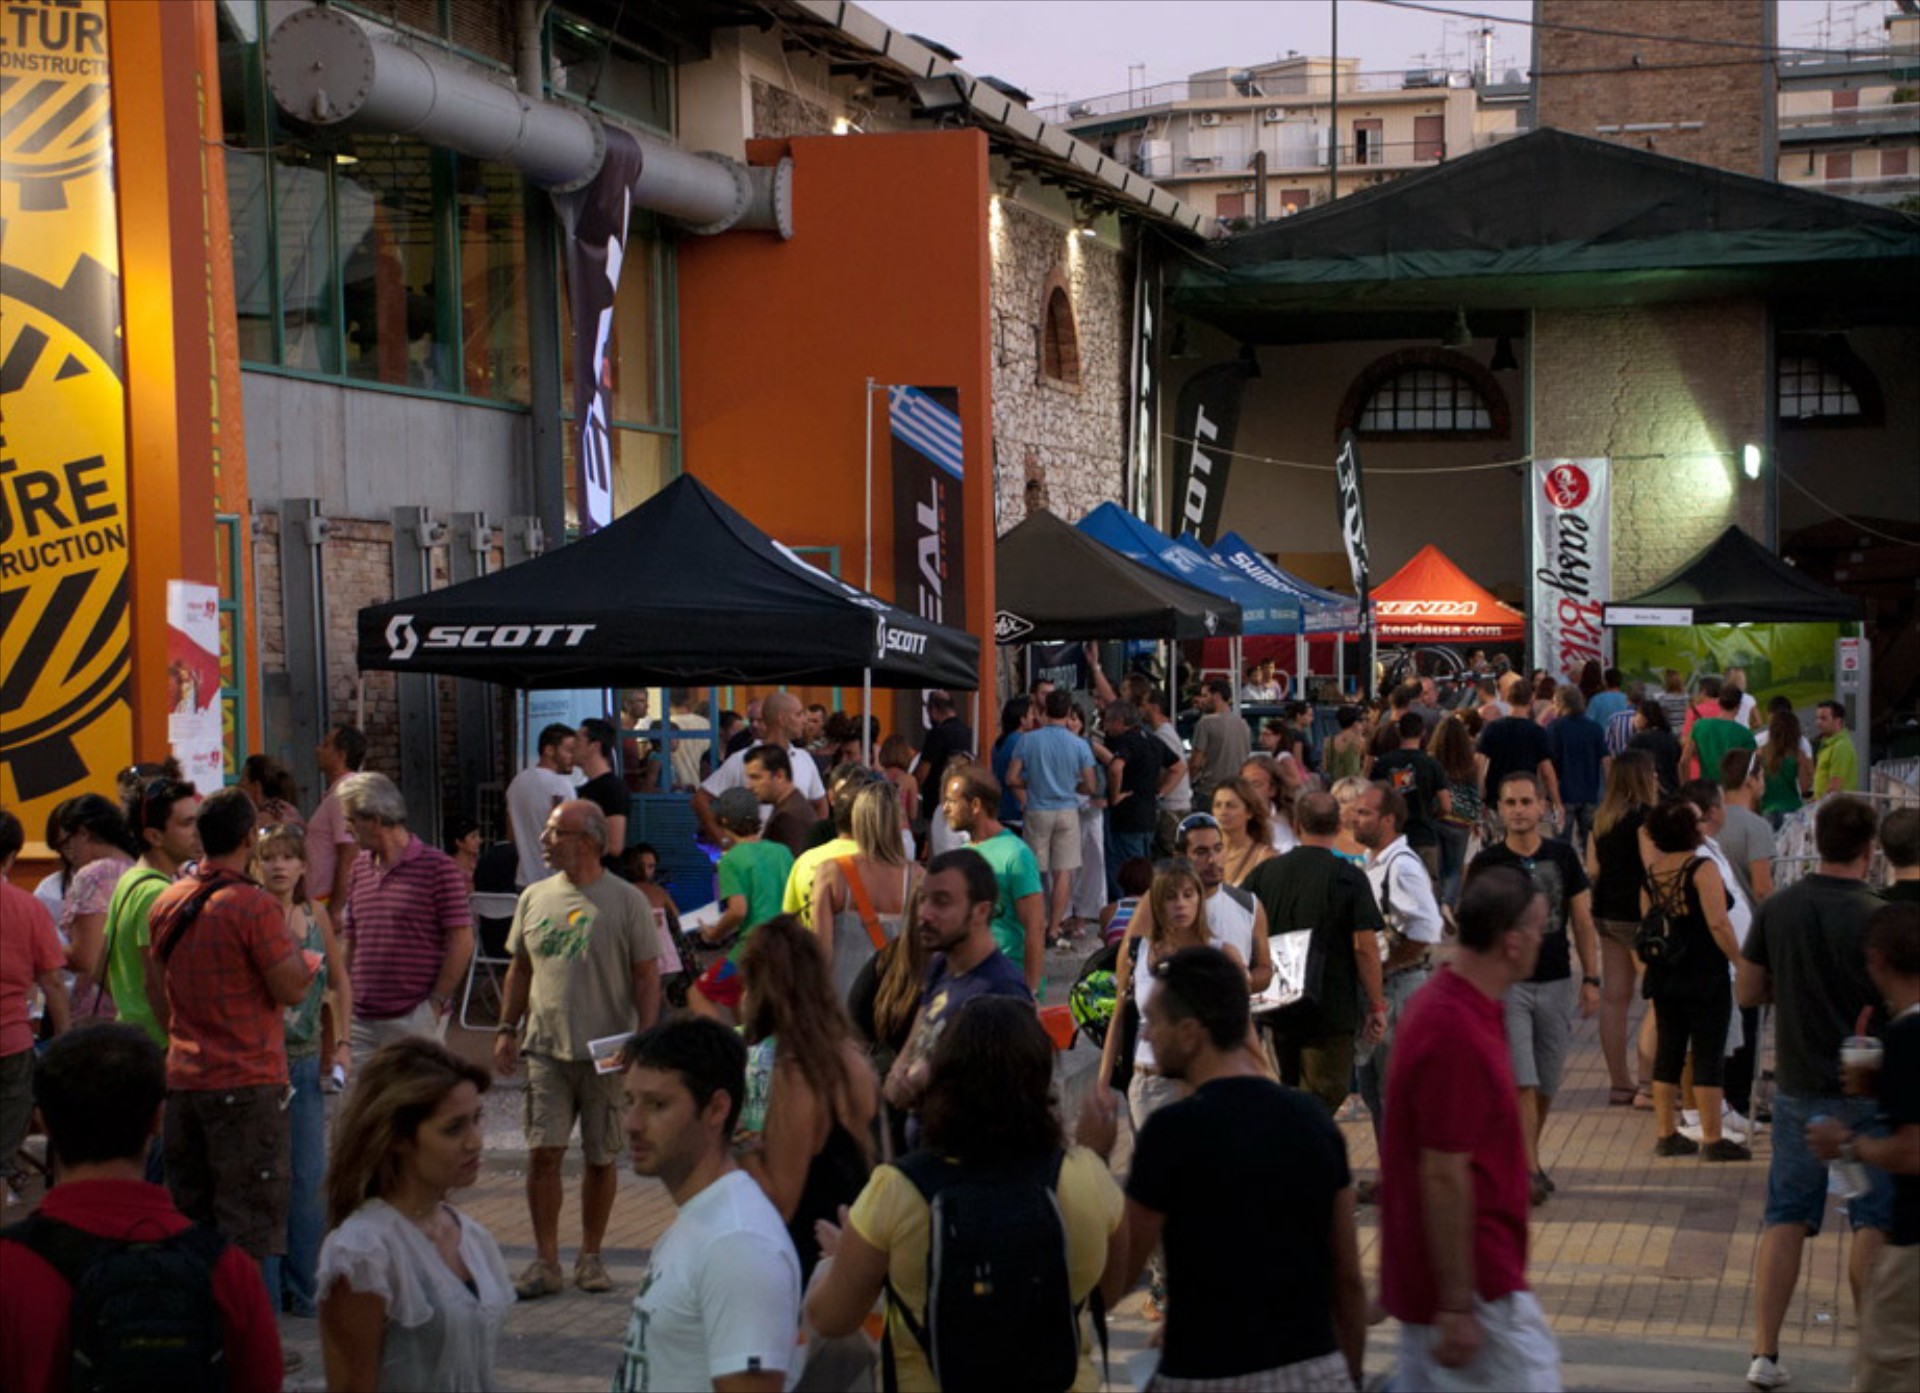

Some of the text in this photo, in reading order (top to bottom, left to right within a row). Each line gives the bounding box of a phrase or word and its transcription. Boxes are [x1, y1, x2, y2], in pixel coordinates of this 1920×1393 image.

[0, 6, 104, 54] TUR
[916, 477, 942, 624] EAL
[1376, 601, 1478, 615] KENDA
[423, 624, 597, 648] SCOTT
[887, 628, 927, 655] SCOTT
